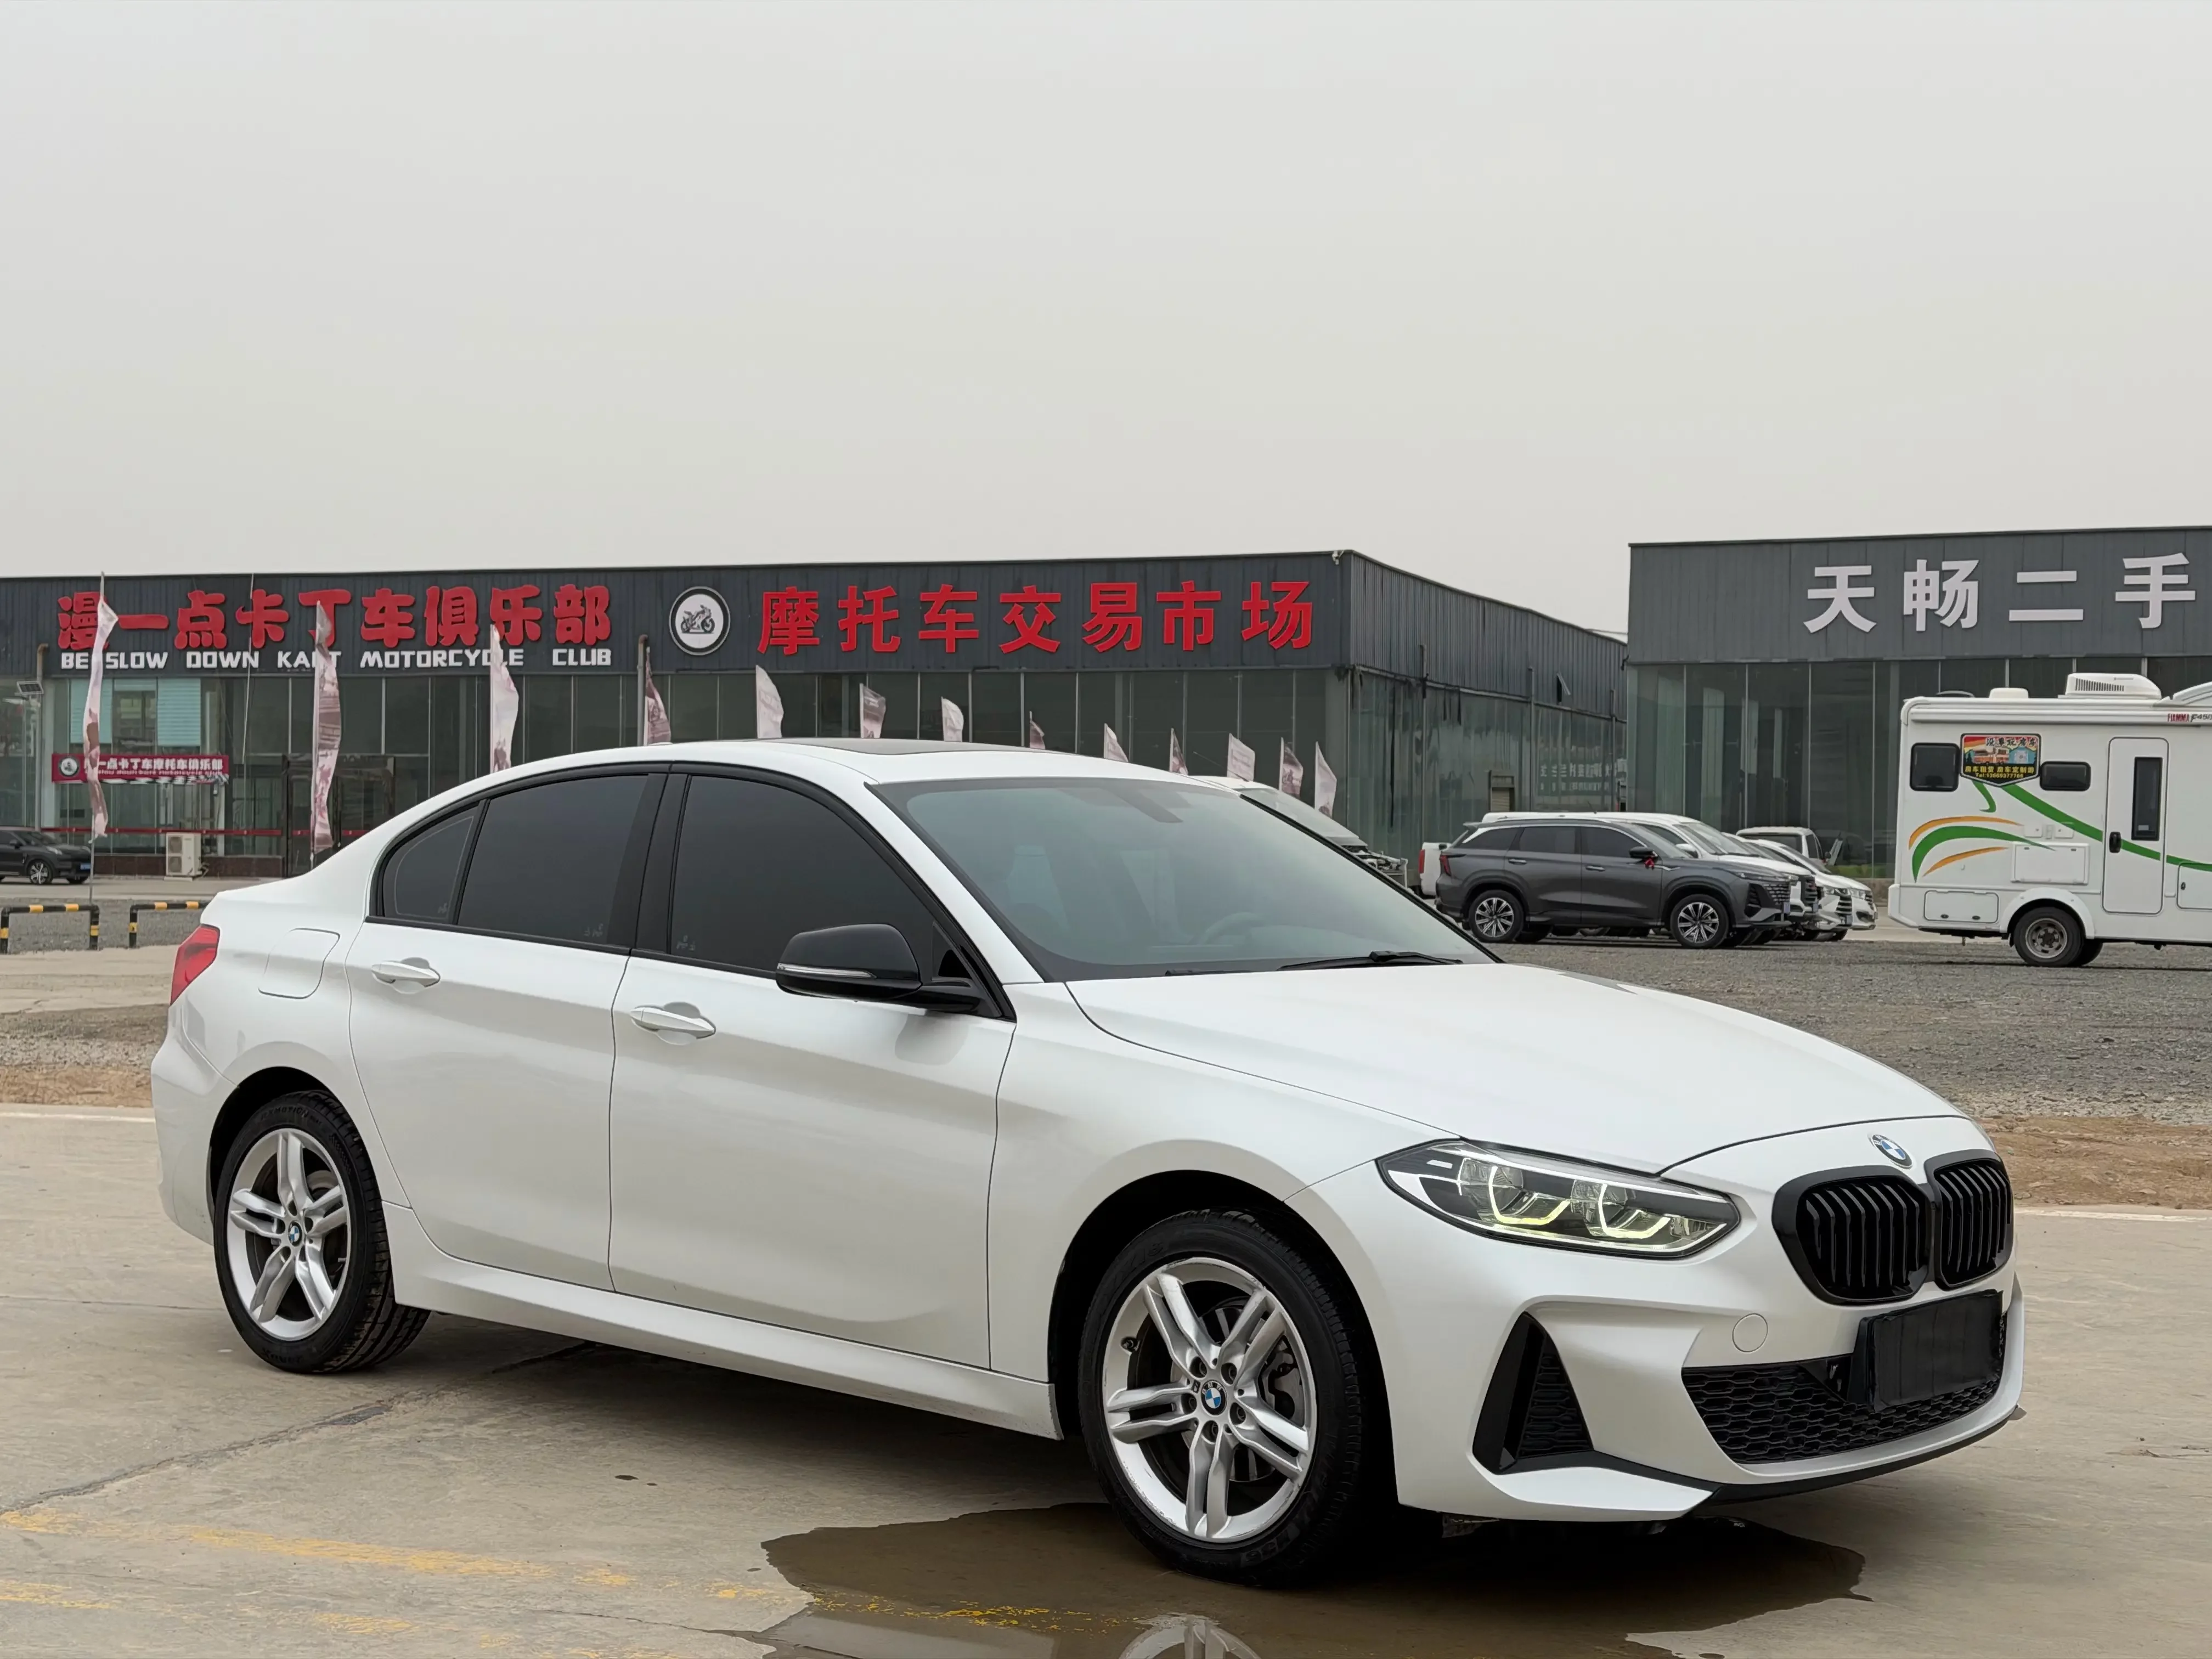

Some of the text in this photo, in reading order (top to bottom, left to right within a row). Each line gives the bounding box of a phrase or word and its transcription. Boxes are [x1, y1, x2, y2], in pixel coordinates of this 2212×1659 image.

[1803, 552, 2196, 633] 天畅二手
[58, 584, 610, 650] 漫一点卡丁车俱乐部
[758, 580, 1312, 656] 摩托车交易市场
[61, 648, 611, 669] BE SLOW DOWN KAT MOTORCYCE CLUB
[2167, 713, 2190, 722] FIAMMA
[84, 758, 223, 771] 一点卡丁车摩托车俱乐部
